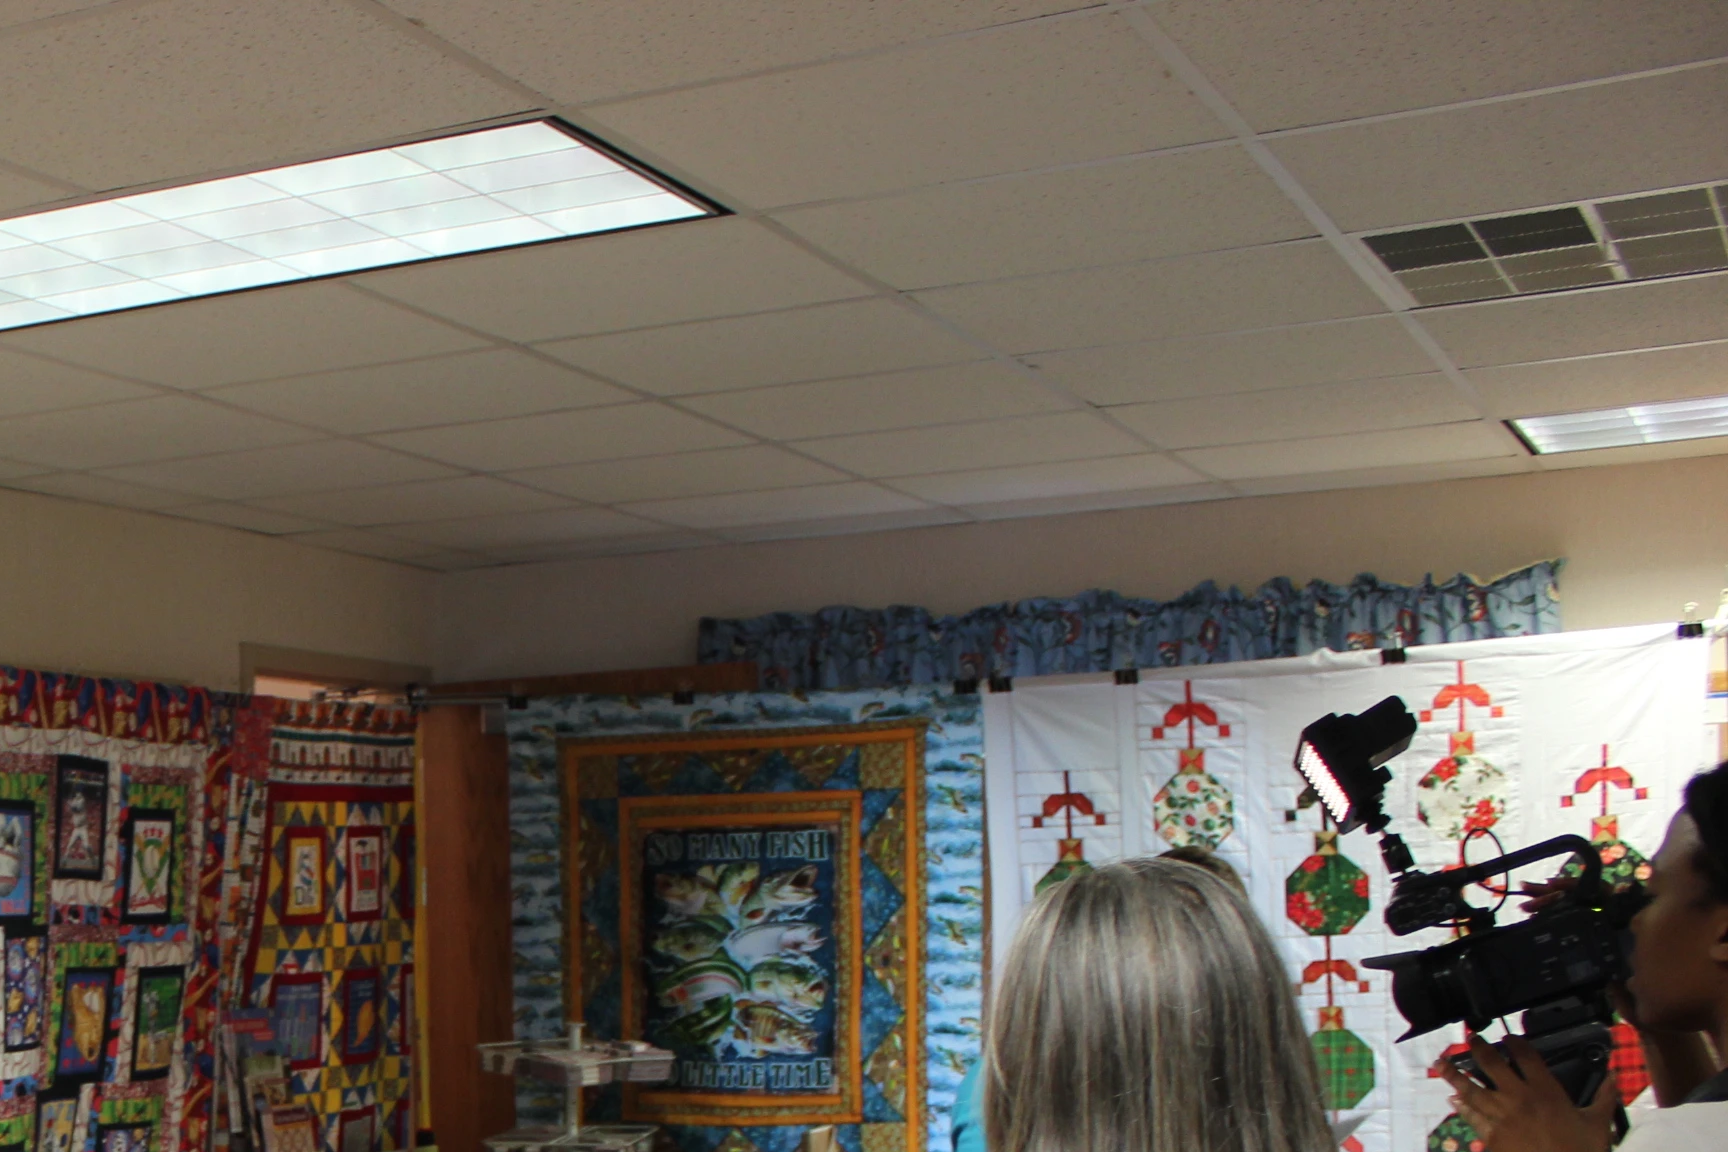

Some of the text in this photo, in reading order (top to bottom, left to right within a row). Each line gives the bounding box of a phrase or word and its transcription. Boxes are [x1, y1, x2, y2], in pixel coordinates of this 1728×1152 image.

[648, 830, 829, 865] SO MANY FISH
[682, 1061, 765, 1088] LITTLE
[770, 1058, 833, 1089] TIME
